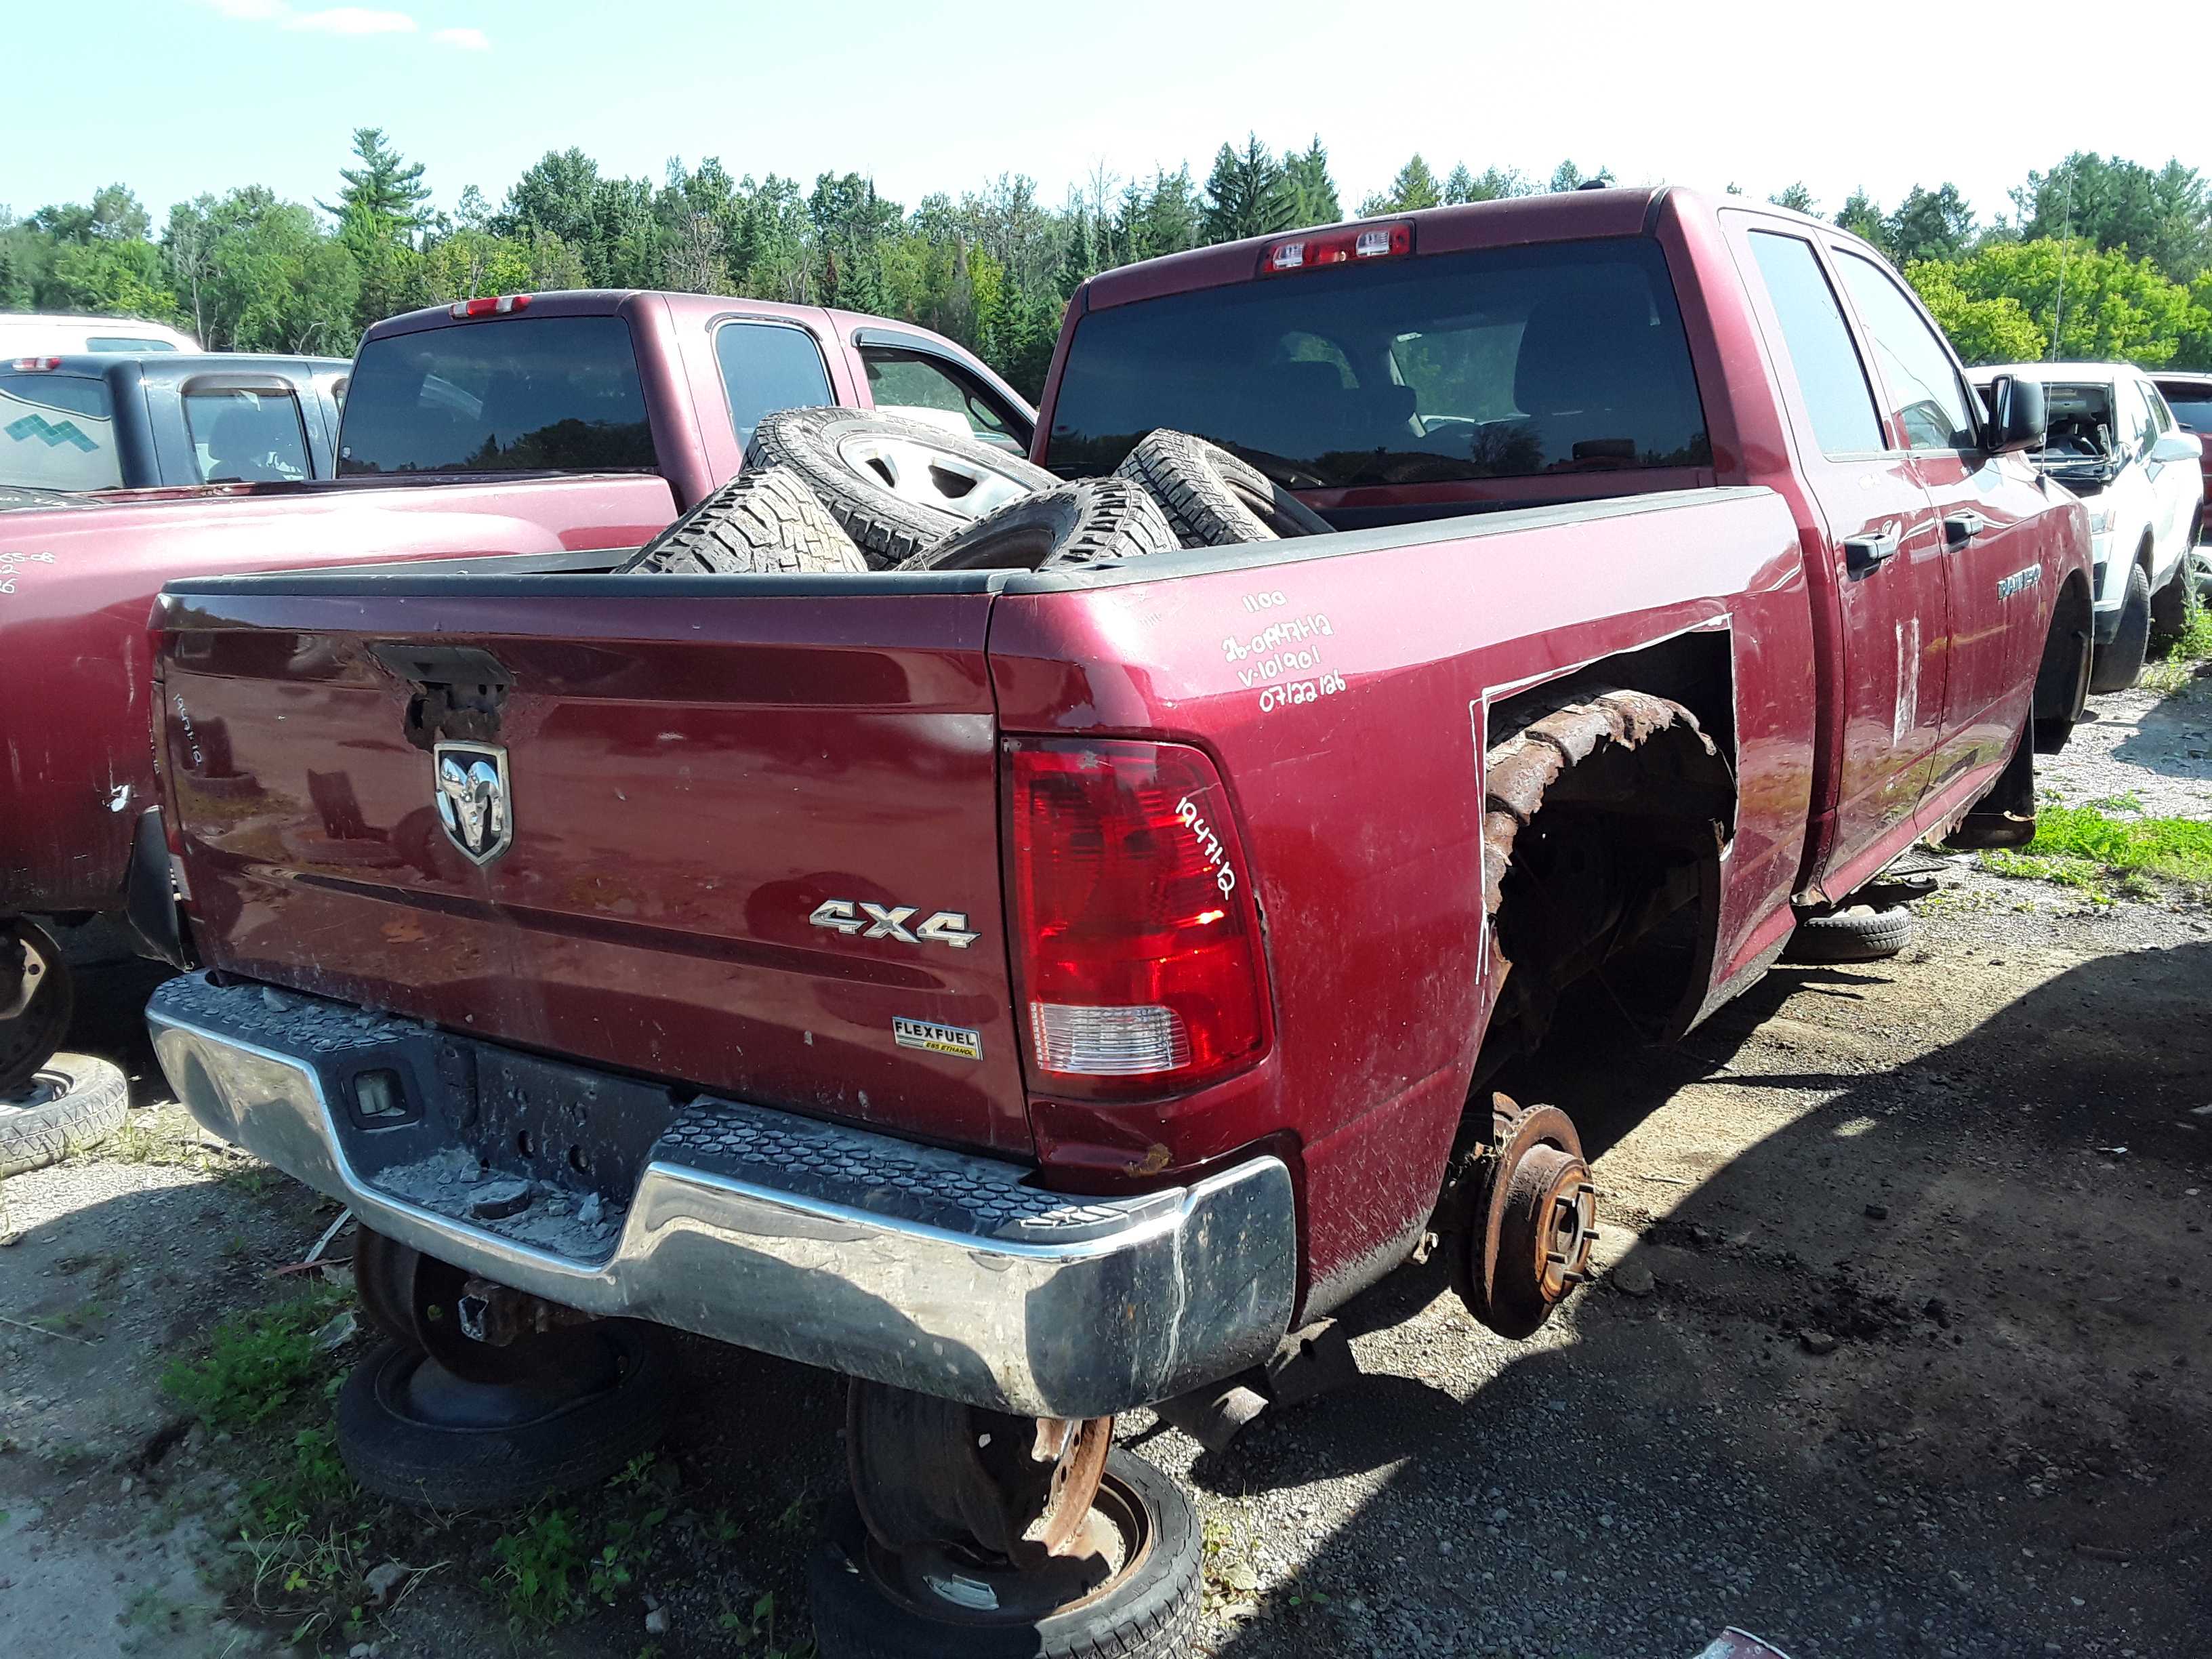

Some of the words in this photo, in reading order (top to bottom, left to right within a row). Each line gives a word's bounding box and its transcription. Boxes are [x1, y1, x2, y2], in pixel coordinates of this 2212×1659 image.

[0, 578, 18, 594] 6
[1242, 590, 1286, 613] 1100
[895, 1021, 975, 1046] FLEXFUEL
[941, 1045, 973, 1056] ETHANOL
